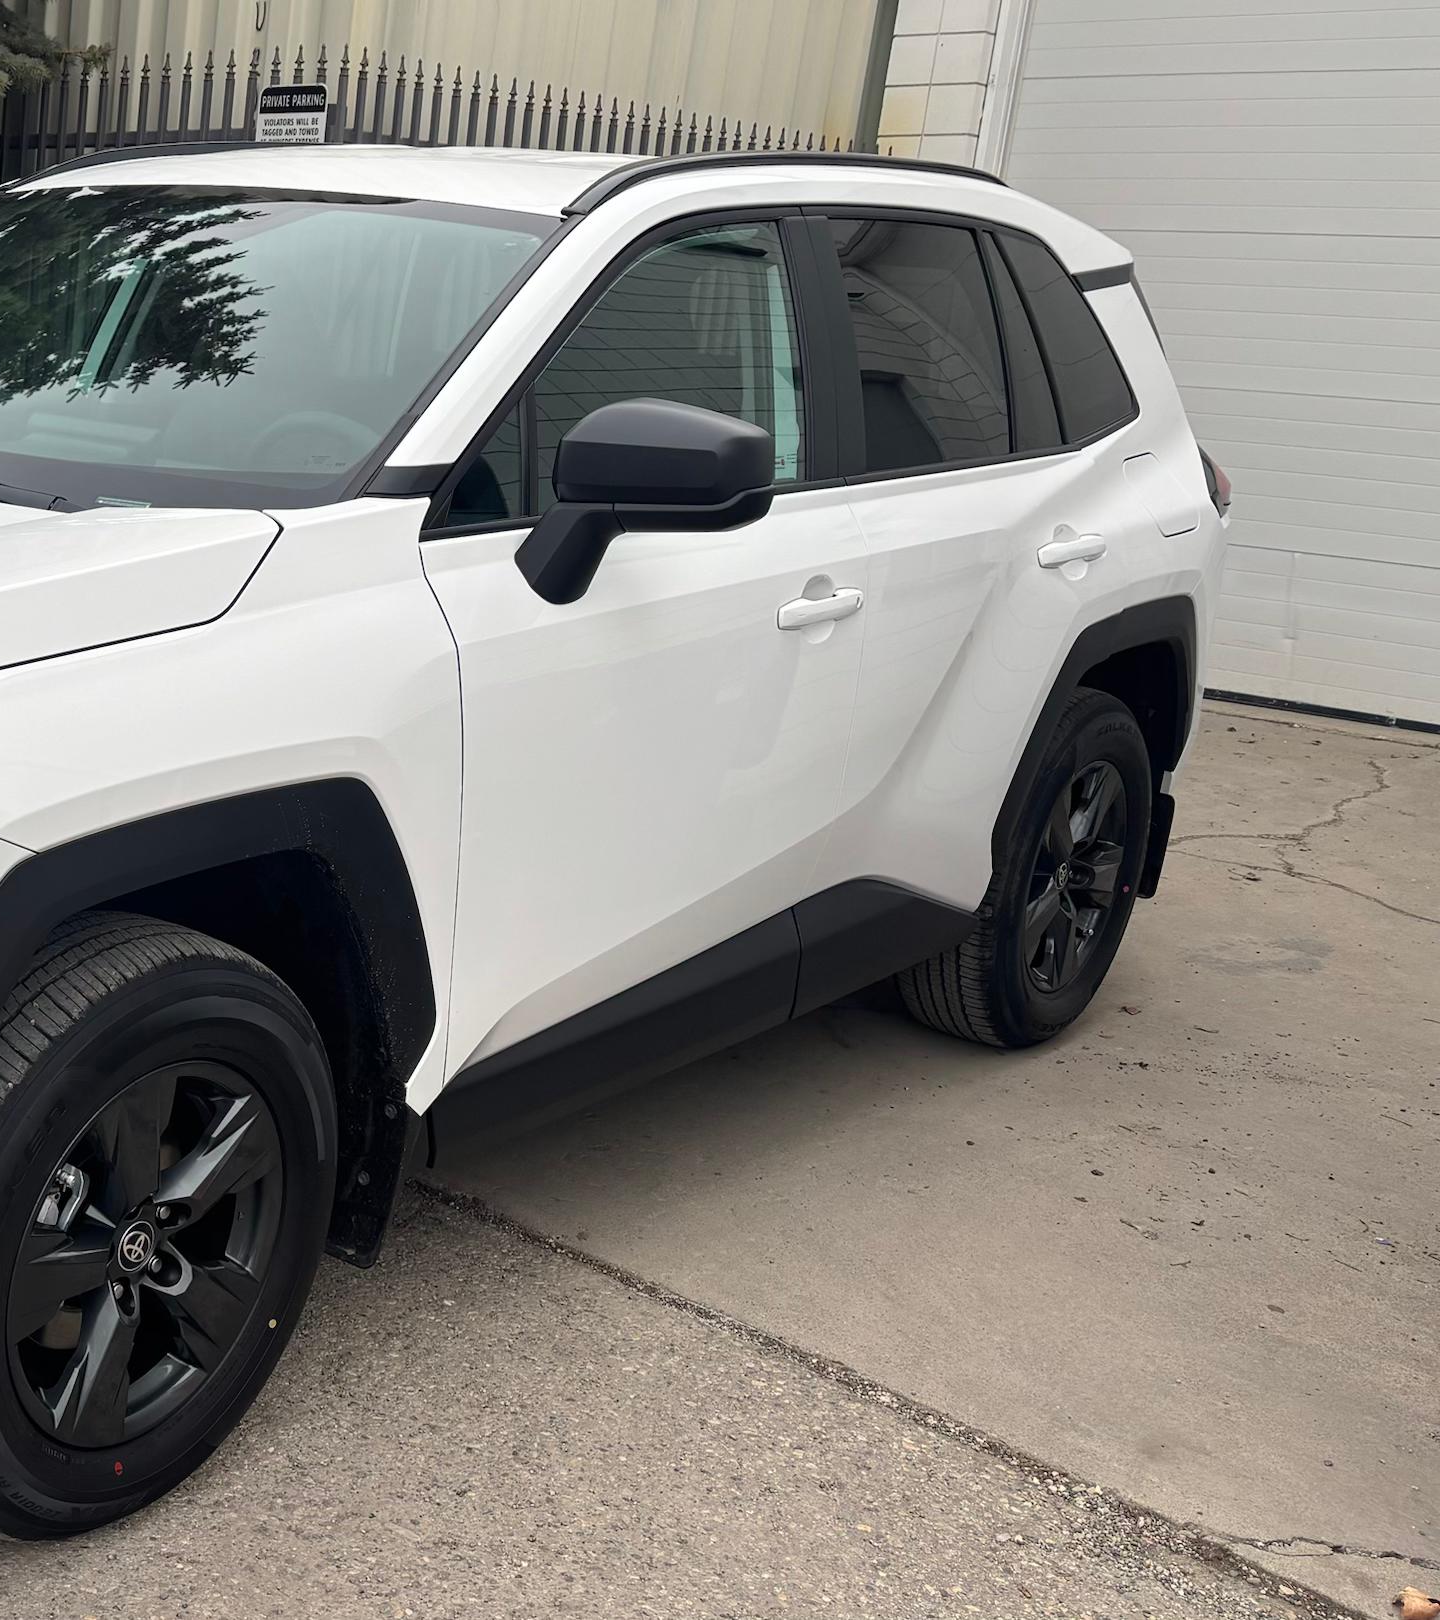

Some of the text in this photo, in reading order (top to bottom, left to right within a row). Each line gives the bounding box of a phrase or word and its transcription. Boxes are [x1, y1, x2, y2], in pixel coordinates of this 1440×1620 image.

[262, 93, 325, 108] PRIVATE PARKING
[264, 117, 319, 127] VIOLATORS WILL BE
[262, 127, 319, 137] TAGGED AND TOWED
